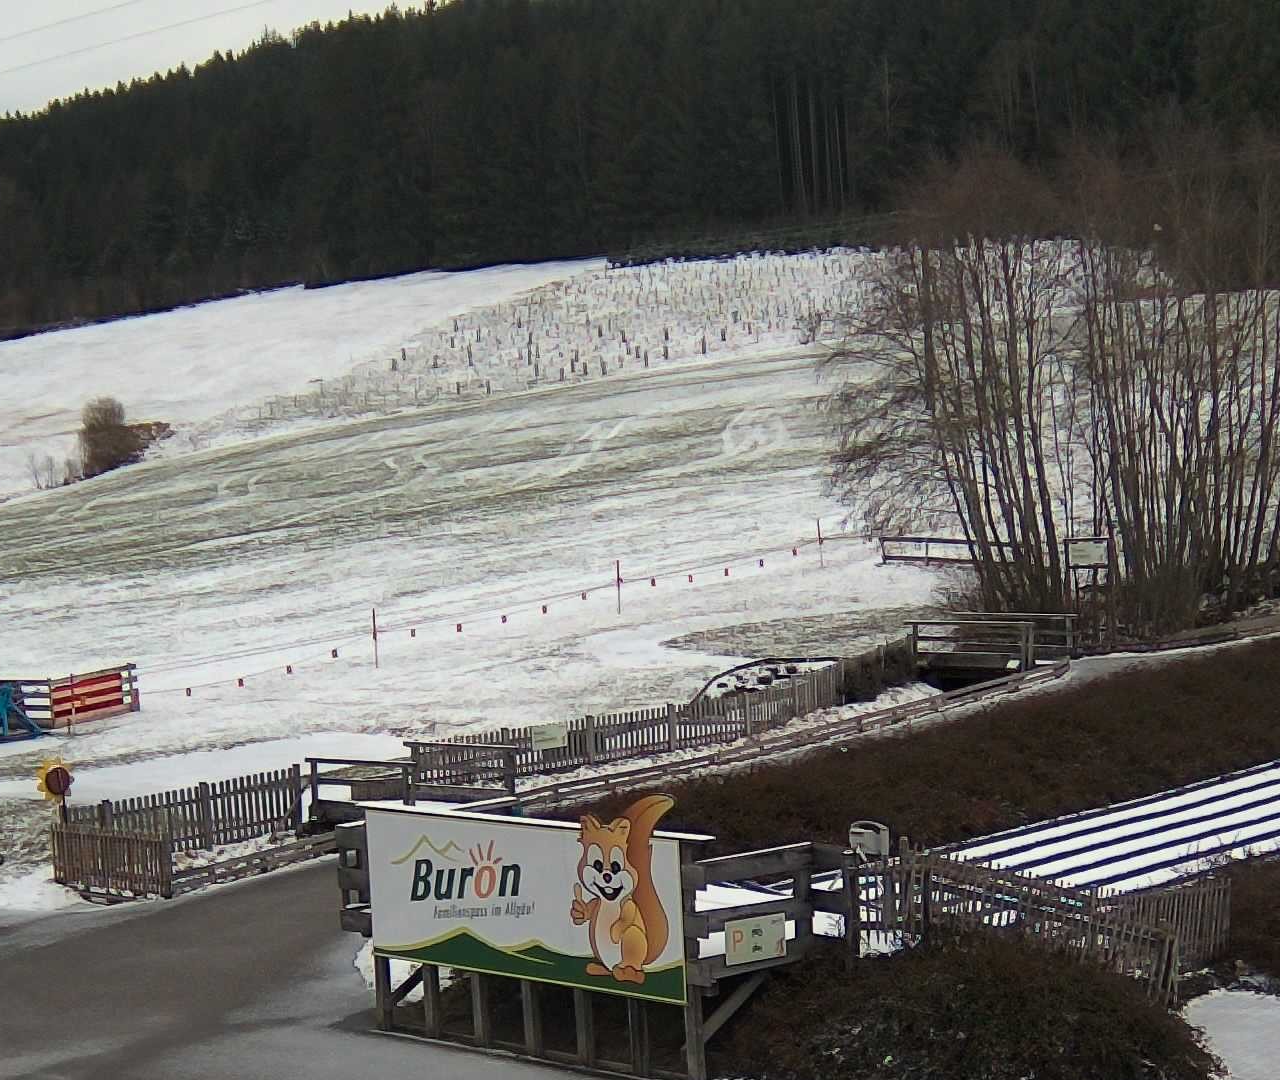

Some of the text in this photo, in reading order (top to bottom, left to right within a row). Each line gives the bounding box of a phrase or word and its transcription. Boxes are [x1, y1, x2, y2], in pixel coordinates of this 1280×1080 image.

[410, 858, 521, 902] Buron
[491, 905, 502, 917] im
[732, 928, 744, 953] P
